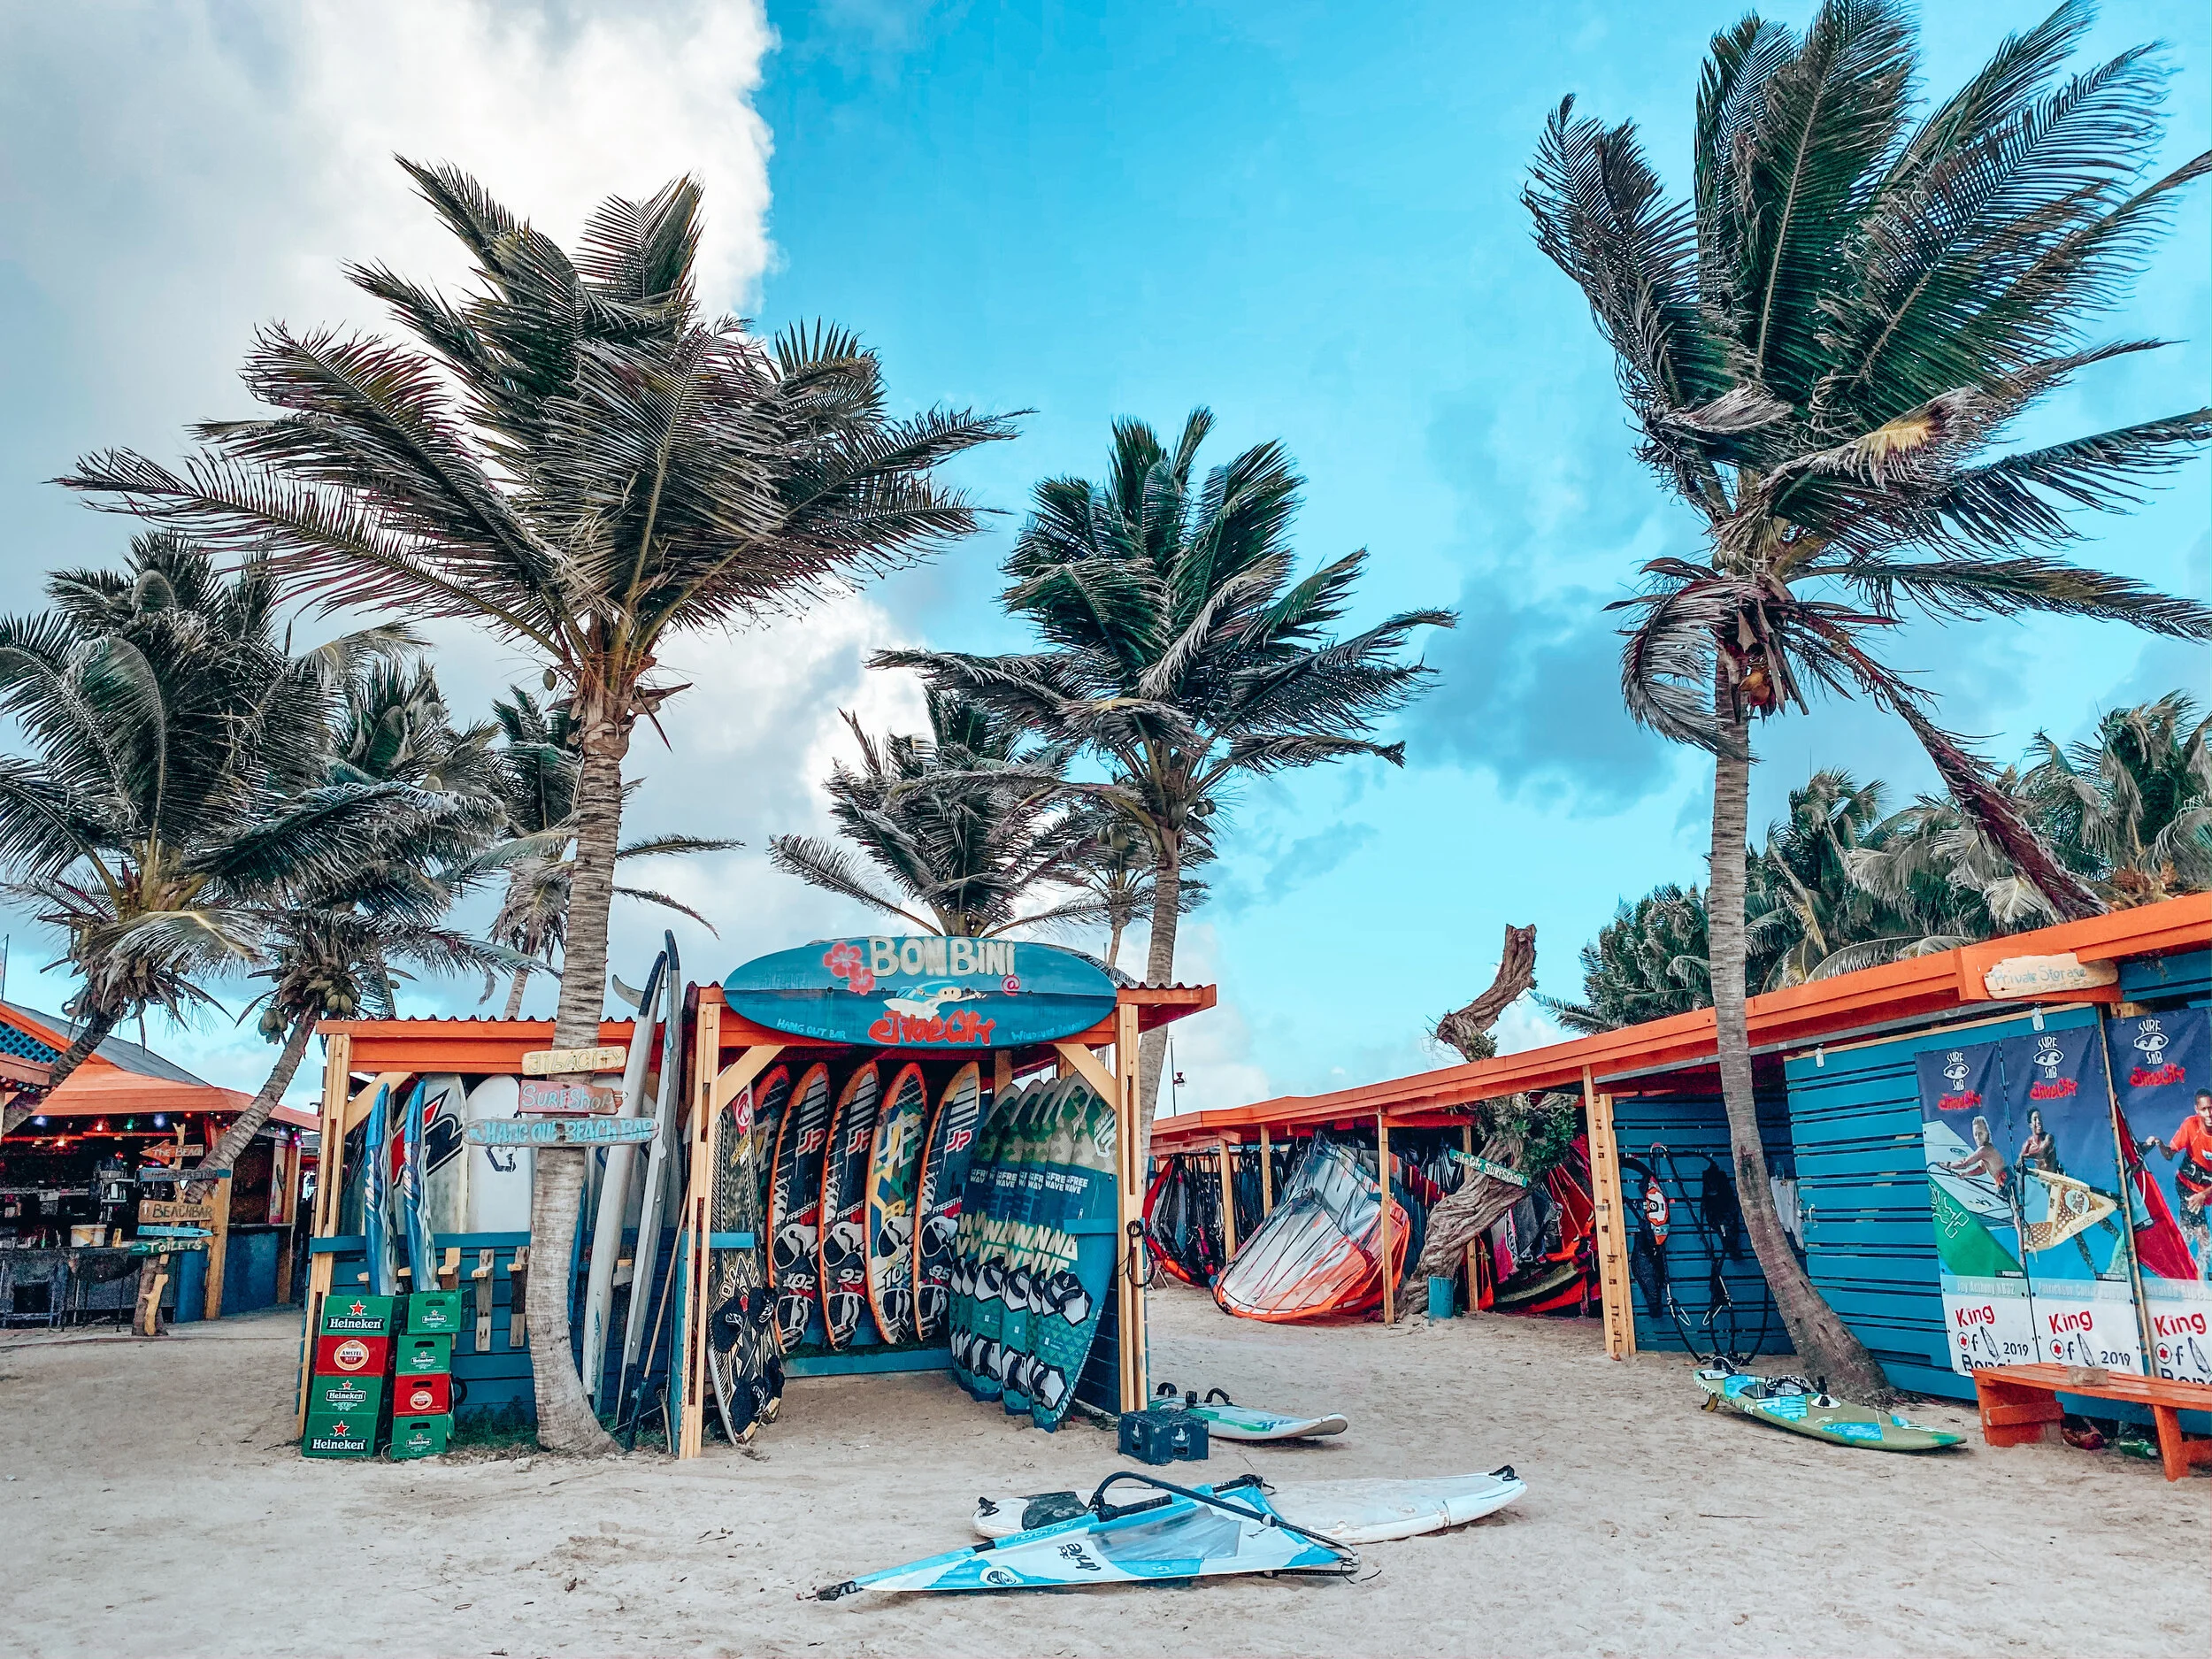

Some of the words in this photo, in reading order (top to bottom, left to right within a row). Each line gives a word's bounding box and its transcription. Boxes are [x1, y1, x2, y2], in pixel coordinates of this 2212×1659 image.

[1991, 970, 2037, 987] Private
[2038, 964, 2087, 982] Storage
[1001, 974, 1020, 996] @
[777, 1018, 804, 1033] HANG
[806, 1025, 827, 1037] OUT
[829, 1029, 847, 1040] BAR
[2139, 1019, 2162, 1034] SURF
[2039, 1036, 2057, 1050] SURF
[1947, 1051, 1964, 1065] SURF
[620, 1119, 655, 1141] BAR
[176, 1147, 203, 1157] BEACH
[1045, 1180, 1064, 1192] WAVE
[1069, 1175, 1089, 1188] FREE
[147, 1239, 203, 1254] TOILETS
[839, 1267, 864, 1285] 93
[329, 1318, 383, 1329] Heineken
[1955, 1305, 1995, 1327] King
[2048, 1310, 2093, 1334] King
[2154, 1313, 2207, 1337] King
[2003, 1342, 2029, 1356] 2019
[2101, 1350, 2131, 1366] 2019
[312, 1439, 365, 1450] Heineken
